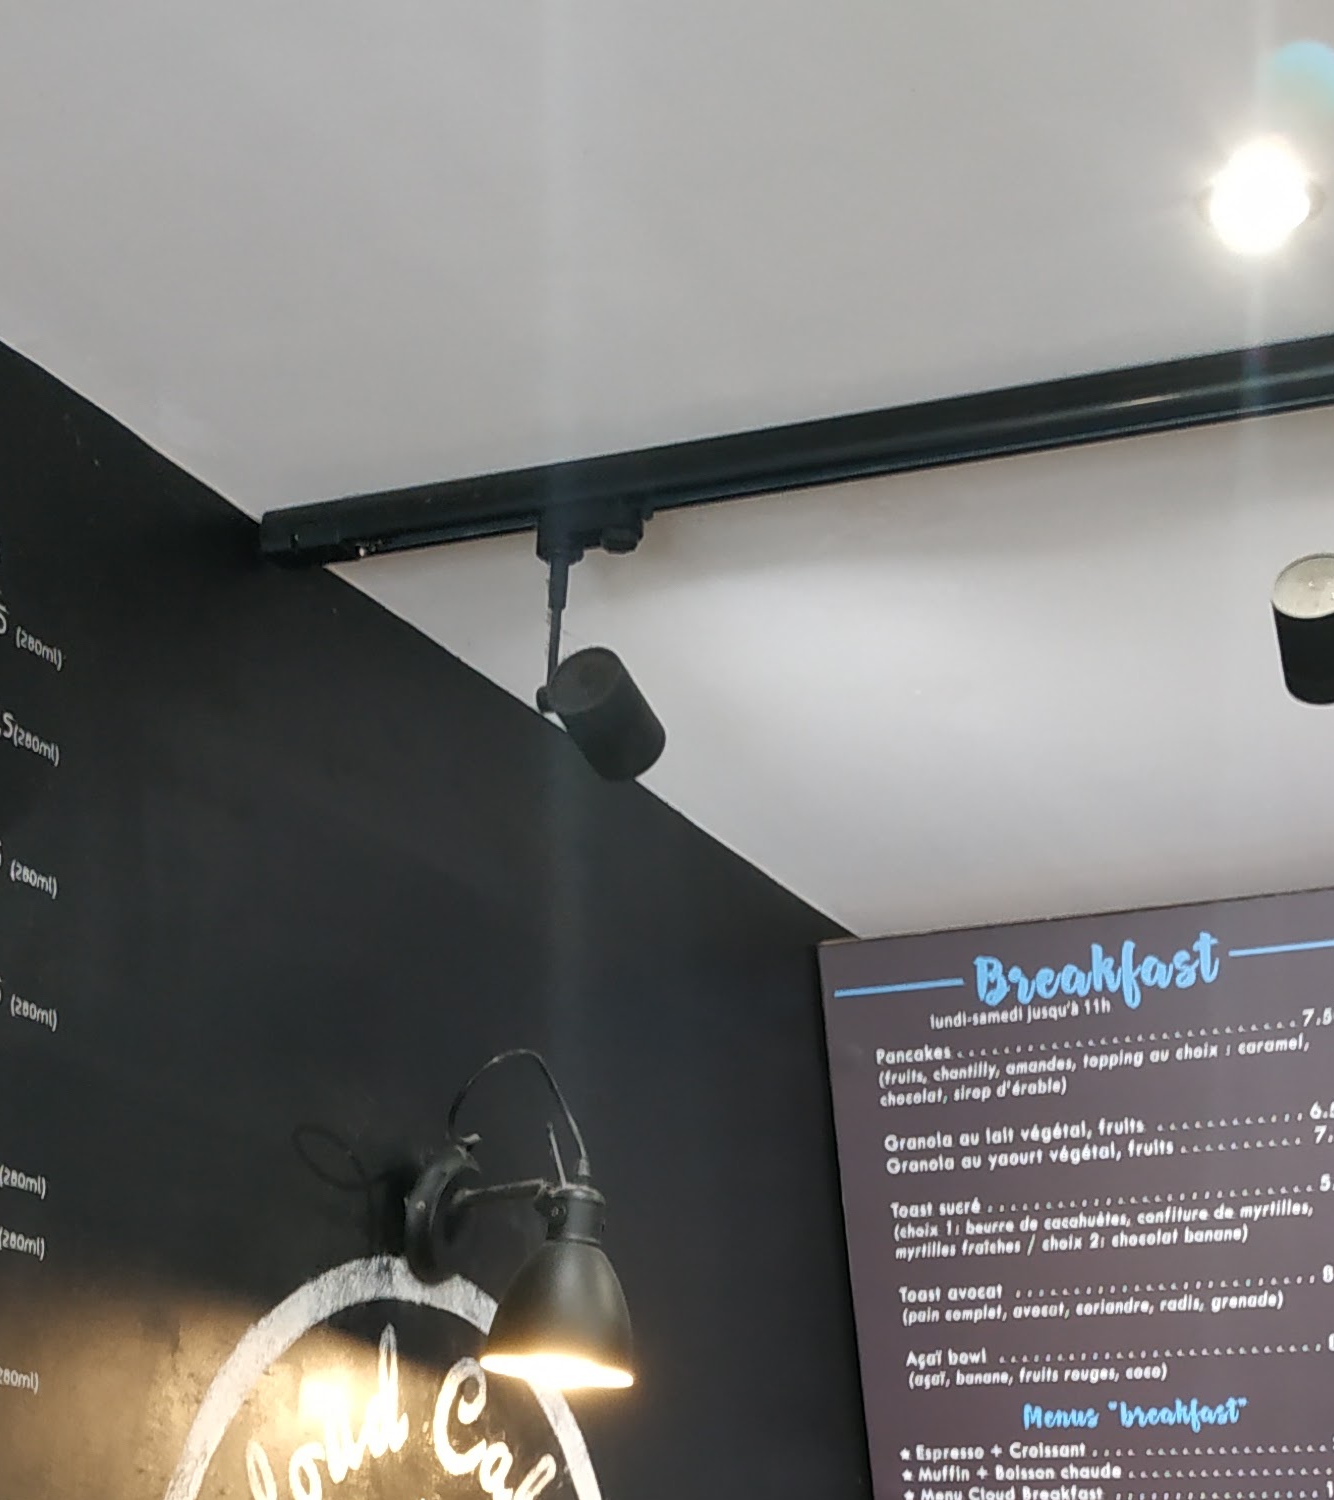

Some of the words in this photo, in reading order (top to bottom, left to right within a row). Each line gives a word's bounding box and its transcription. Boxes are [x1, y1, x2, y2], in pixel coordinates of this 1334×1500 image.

[974, 931, 1220, 1009] Breakfast
[876, 1044, 951, 1065] Pancakes
[884, 1131, 952, 1152] Granola
[959, 1133, 979, 1146] au
[986, 1126, 1014, 1144] lait
[1020, 1120, 1092, 1144] végétal,
[1098, 1117, 1144, 1136] fruits
[890, 1202, 933, 1218] Toast
[939, 1197, 981, 1216] sucré
[1023, 1403, 1099, 1430] Menus
[916, 1444, 984, 1463] Espresso
[991, 1444, 1002, 1457] +
[1009, 1442, 1086, 1459] Croissant
